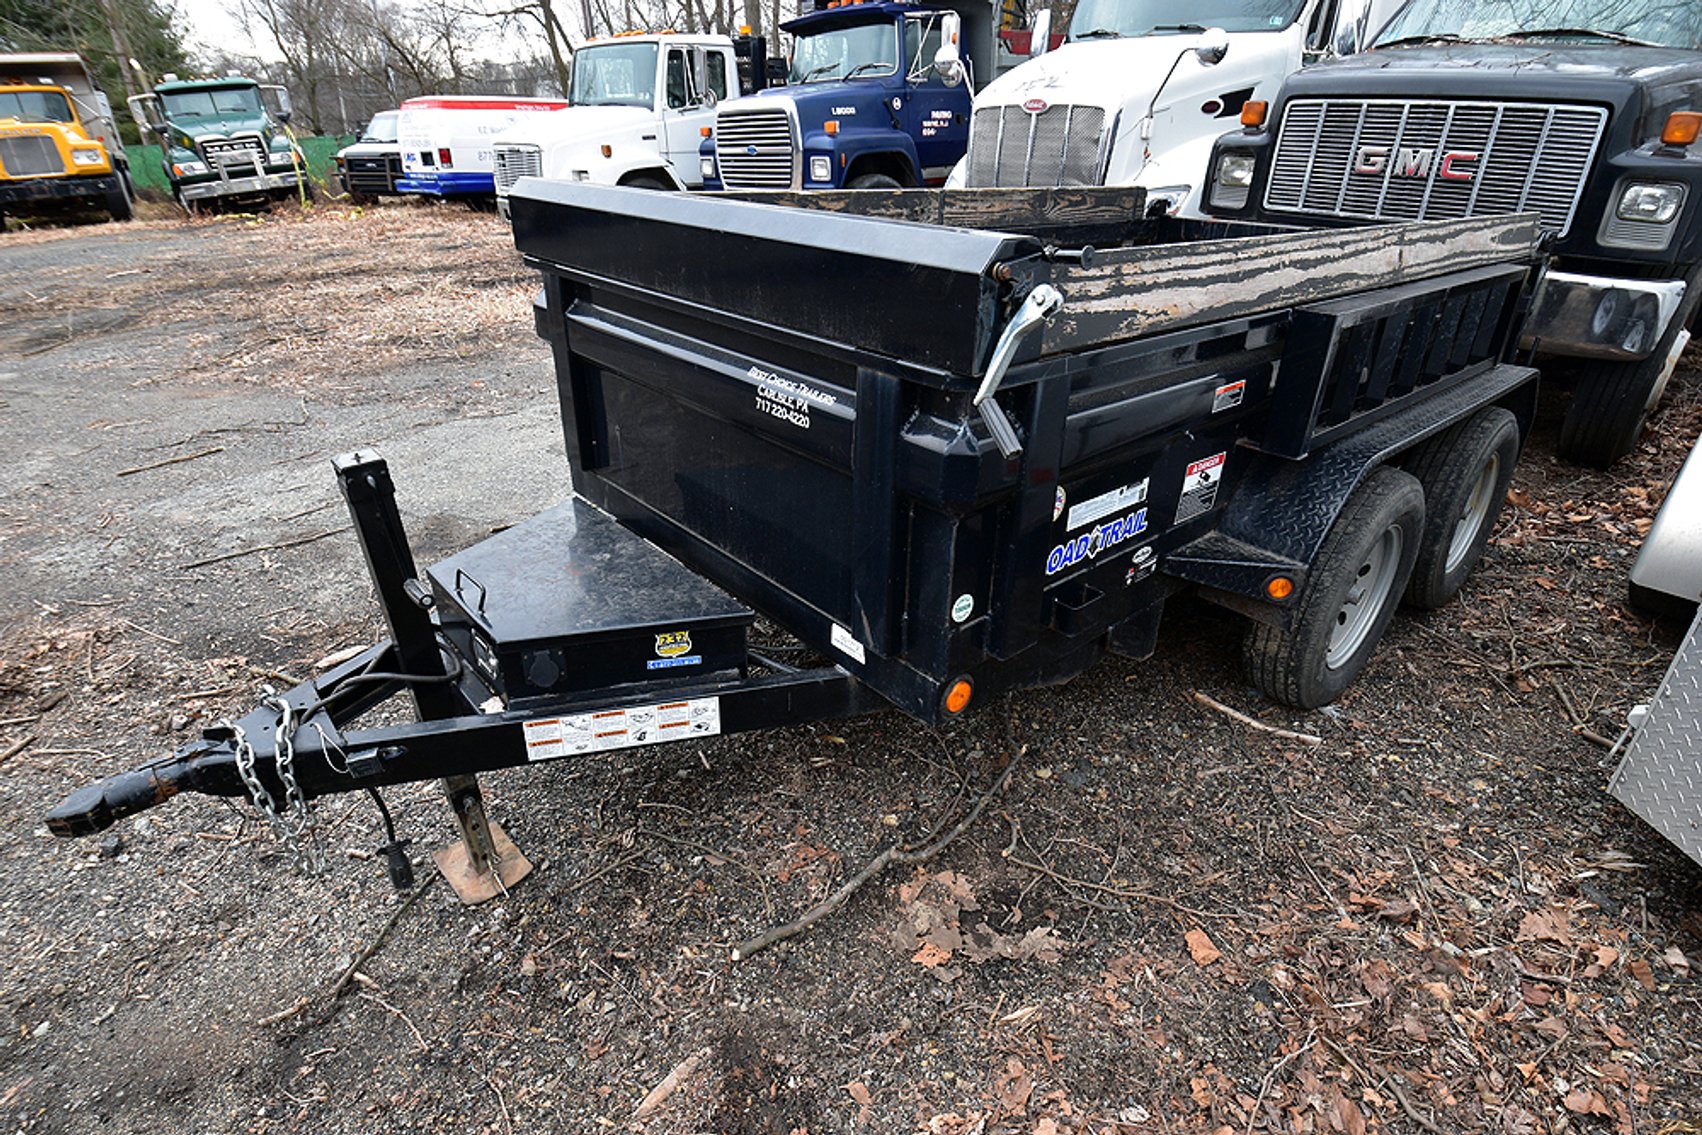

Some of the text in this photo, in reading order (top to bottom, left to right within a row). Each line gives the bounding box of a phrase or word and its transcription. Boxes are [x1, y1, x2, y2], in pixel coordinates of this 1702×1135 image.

[1354, 146, 1480, 180] GMC
[796, 397, 809, 413] PA
[1098, 507, 1148, 551] TRAIL
